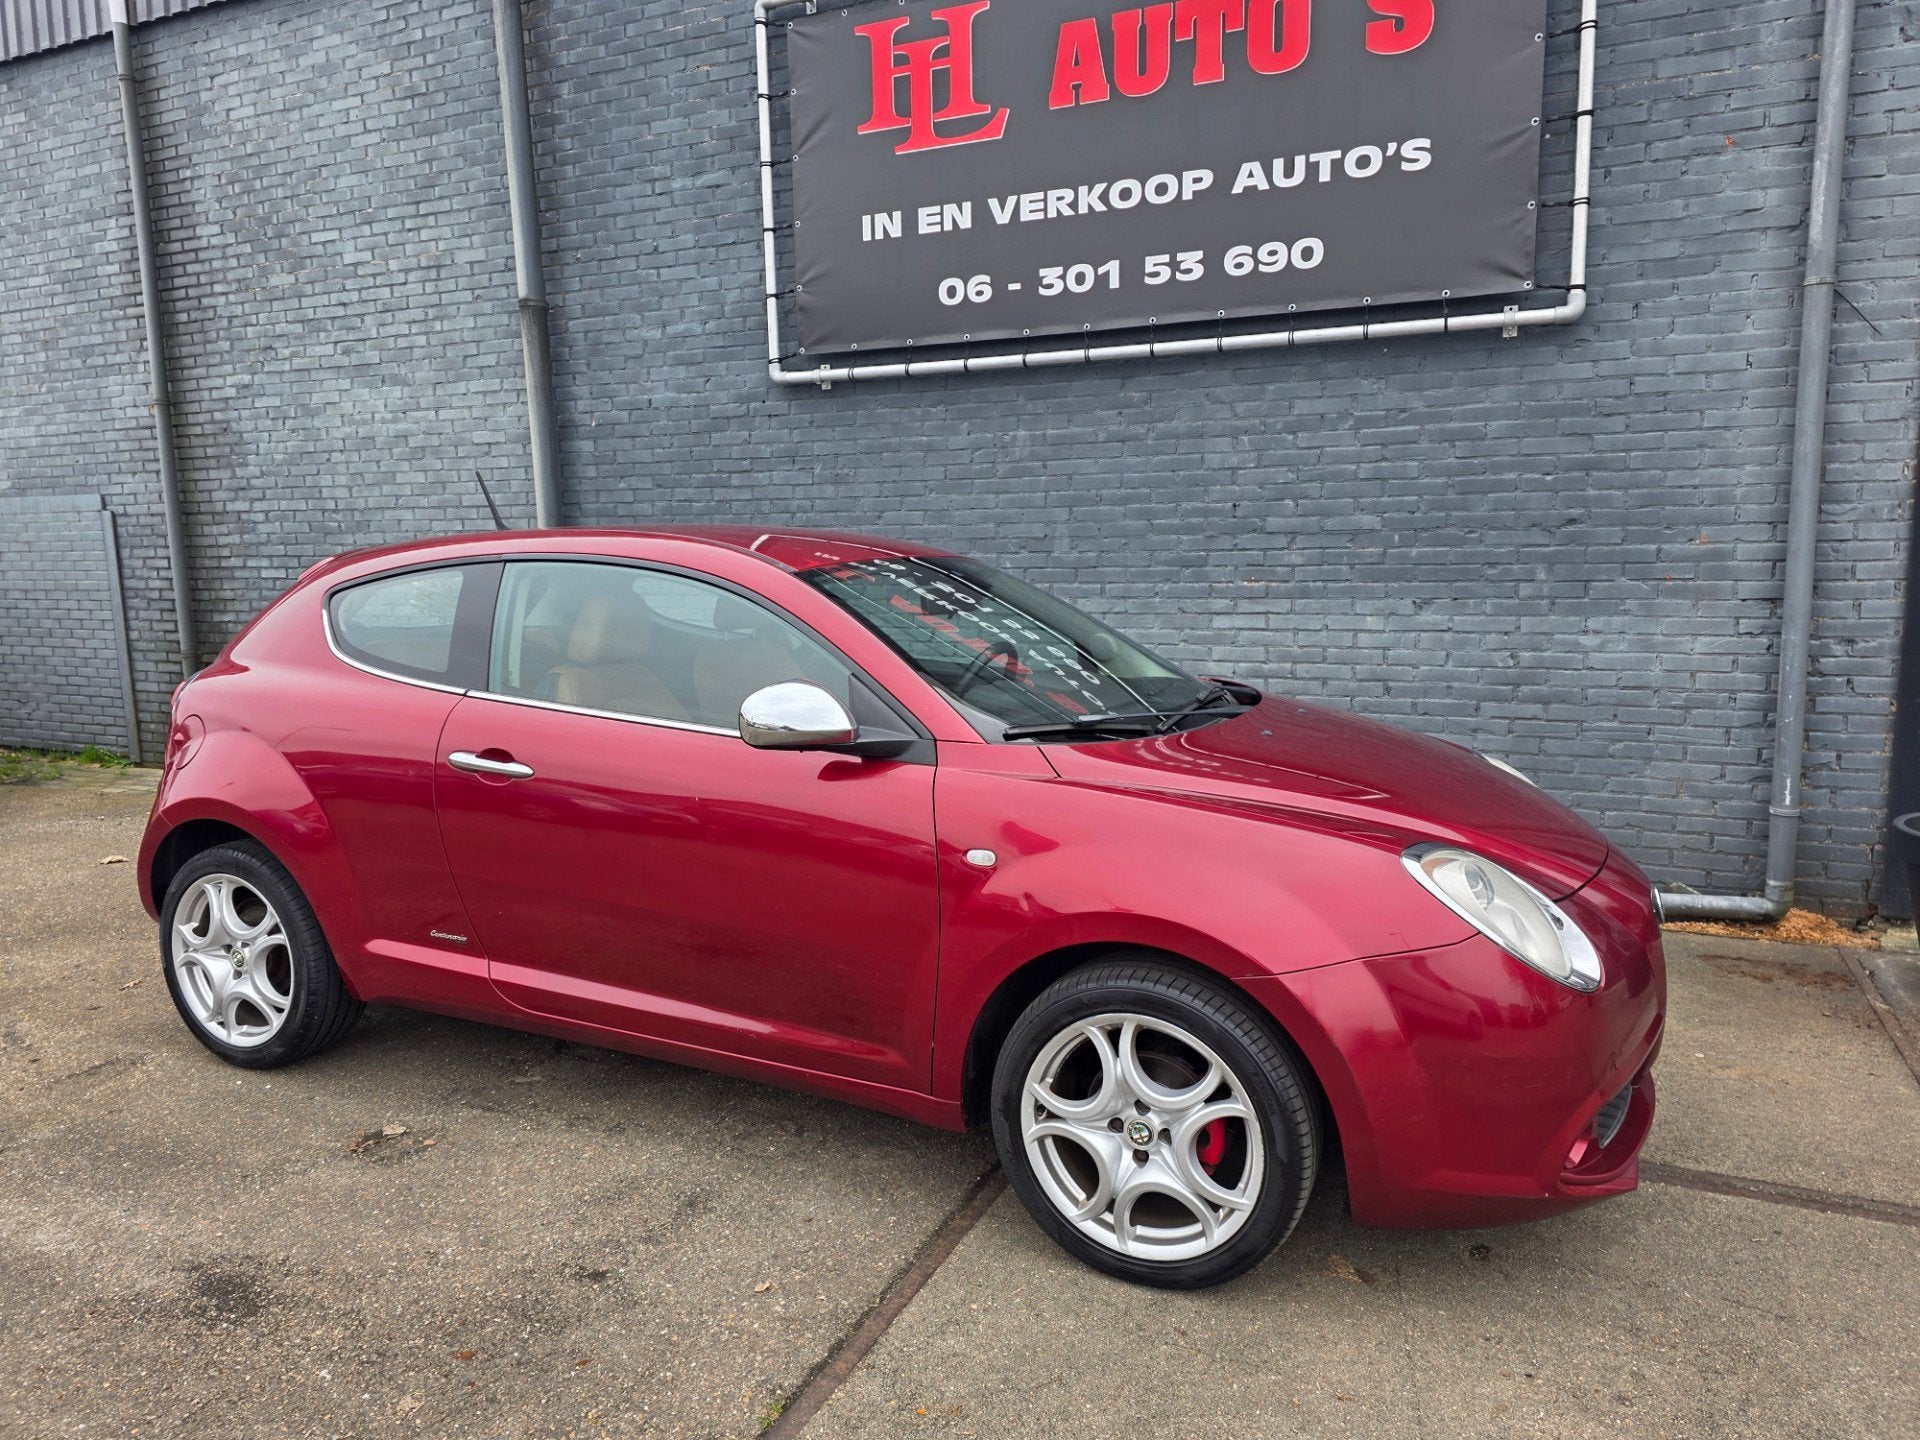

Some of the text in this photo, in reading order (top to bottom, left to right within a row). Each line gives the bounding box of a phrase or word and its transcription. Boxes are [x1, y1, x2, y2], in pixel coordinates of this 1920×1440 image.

[1049, 0, 1435, 110] AUTOS
[862, 137, 1432, 242] IN EN VERKOOP AUTO'S
[938, 237, 1325, 306] 06 - 301 53 690
